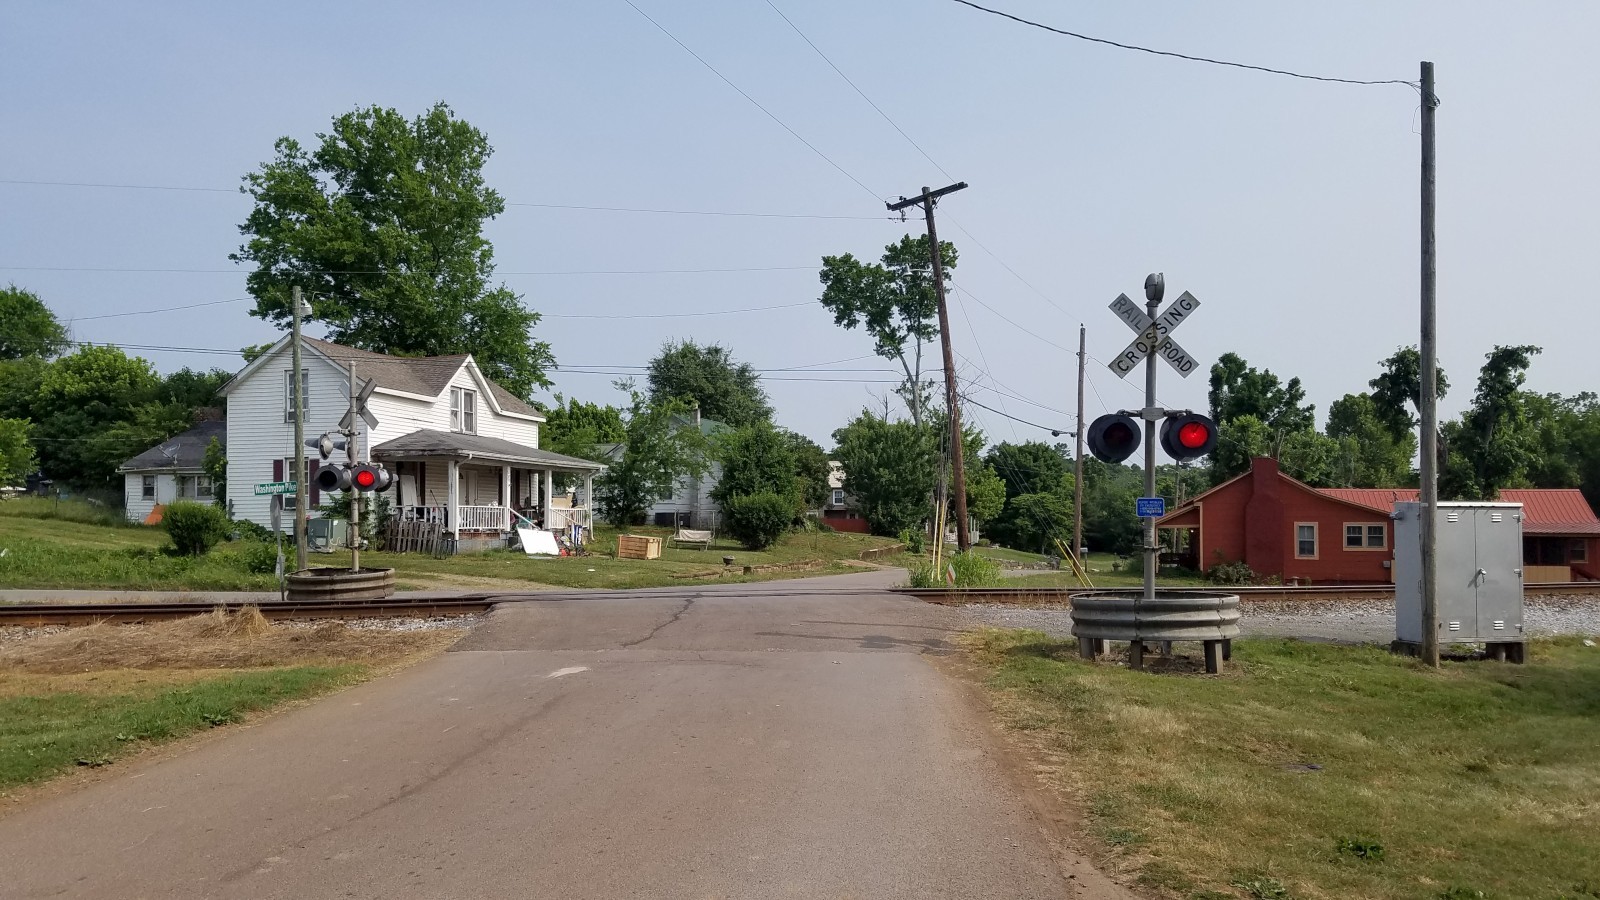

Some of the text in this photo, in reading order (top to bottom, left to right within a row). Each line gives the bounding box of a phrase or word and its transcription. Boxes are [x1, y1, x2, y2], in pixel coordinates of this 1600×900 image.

[1114, 297, 1141, 331] RAIL
[1117, 299, 1192, 372] CROSSING
[1159, 341, 1192, 372] ROAD
[255, 483, 297, 494] Washington Pike
